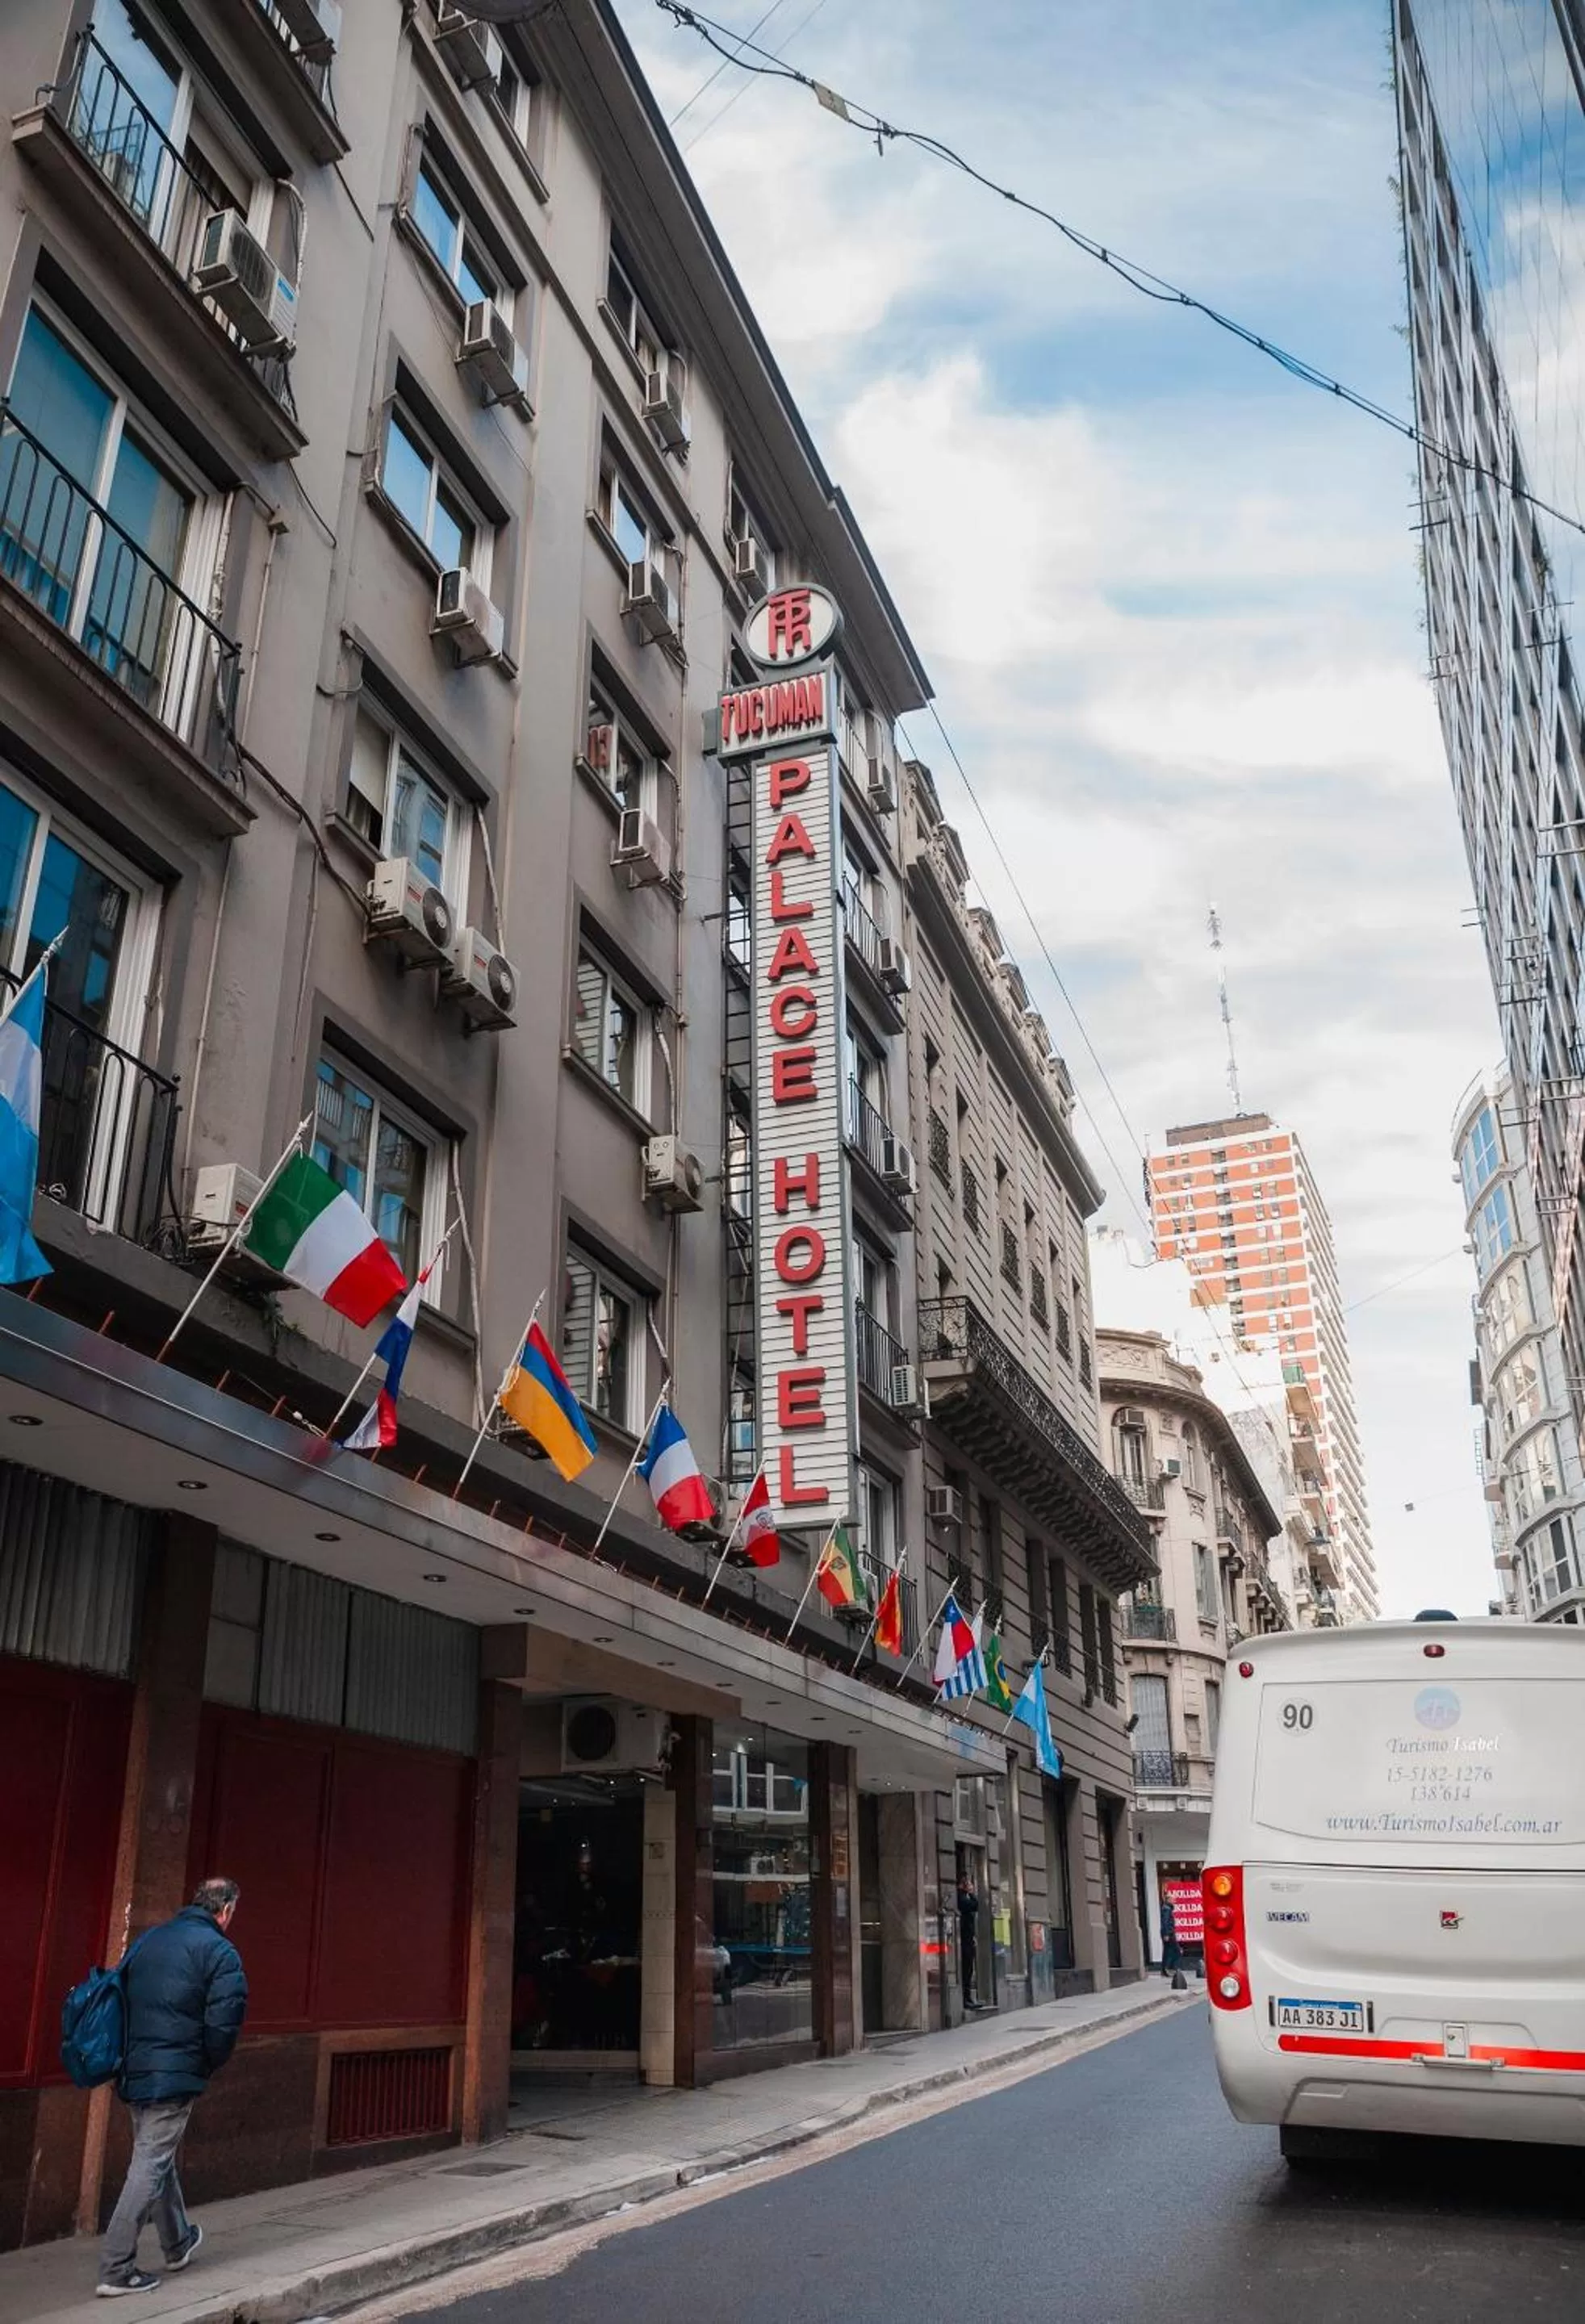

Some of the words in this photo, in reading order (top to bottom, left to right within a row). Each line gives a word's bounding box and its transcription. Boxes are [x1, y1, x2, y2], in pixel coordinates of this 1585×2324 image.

[721, 673, 823, 742] TUCUMAN
[765, 758, 819, 1106] PALACE
[774, 1152, 830, 1506] HOTEL
[1283, 1703, 1313, 1729] 90
[1386, 1737, 1449, 1753] Turismo
[1453, 1736, 1499, 1752] Isabel
[1387, 1766, 1493, 1783] 15-5182-1276
[1325, 1813, 1562, 1833] www.TurismoIsabel.com.ar
[1282, 2008, 1301, 2024] AA
[1307, 2009, 1334, 2025] 383
